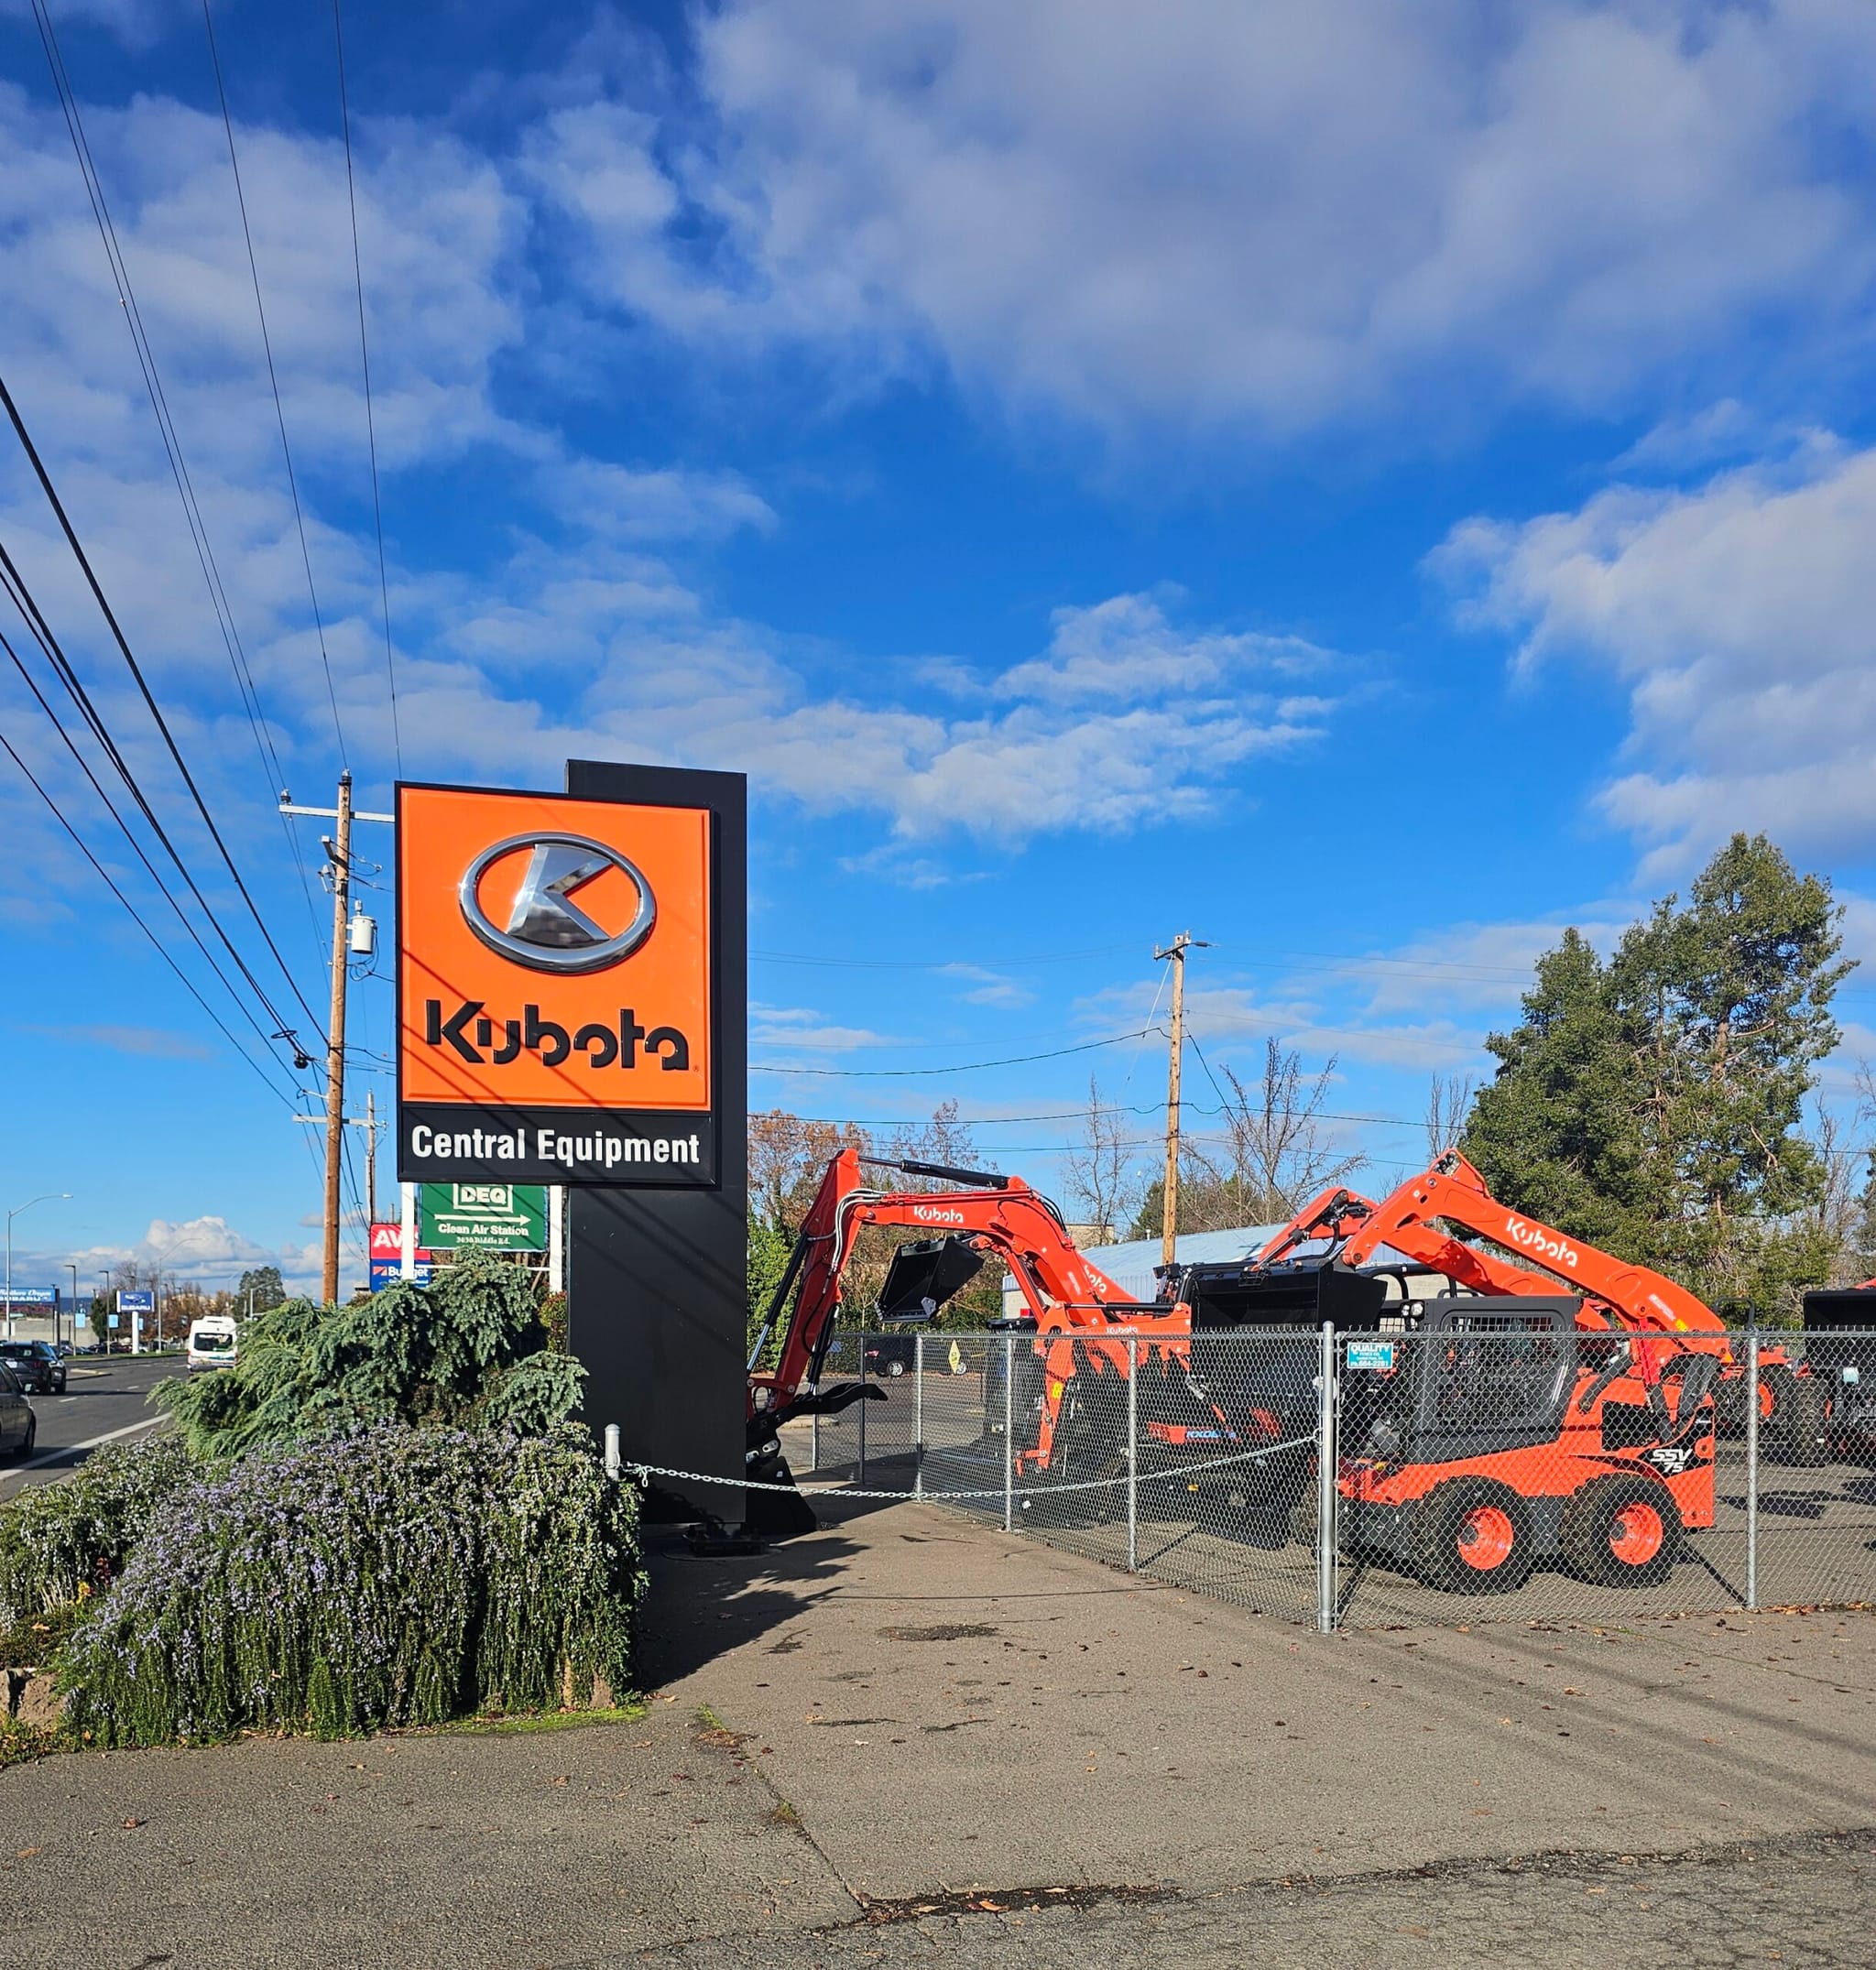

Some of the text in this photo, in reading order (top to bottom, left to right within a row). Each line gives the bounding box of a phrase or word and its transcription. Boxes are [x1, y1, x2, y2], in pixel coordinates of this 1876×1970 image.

[426, 999, 690, 1071] Kubota
[411, 1125, 700, 1168] Central Equipment
[461, 1186, 507, 1204] DEQ
[913, 1205, 964, 1224] Kubota
[438, 1223, 529, 1236] Clean Air Station
[373, 1229, 419, 1248] AV
[1506, 1216, 1578, 1268] Kubota
[387, 1266, 429, 1279] Buget
[1106, 1325, 1138, 1334] Kubota
[1350, 1345, 1391, 1355] QUALITY
[1650, 1448, 1694, 1462] SSV
[1663, 1462, 1685, 1473] 75
